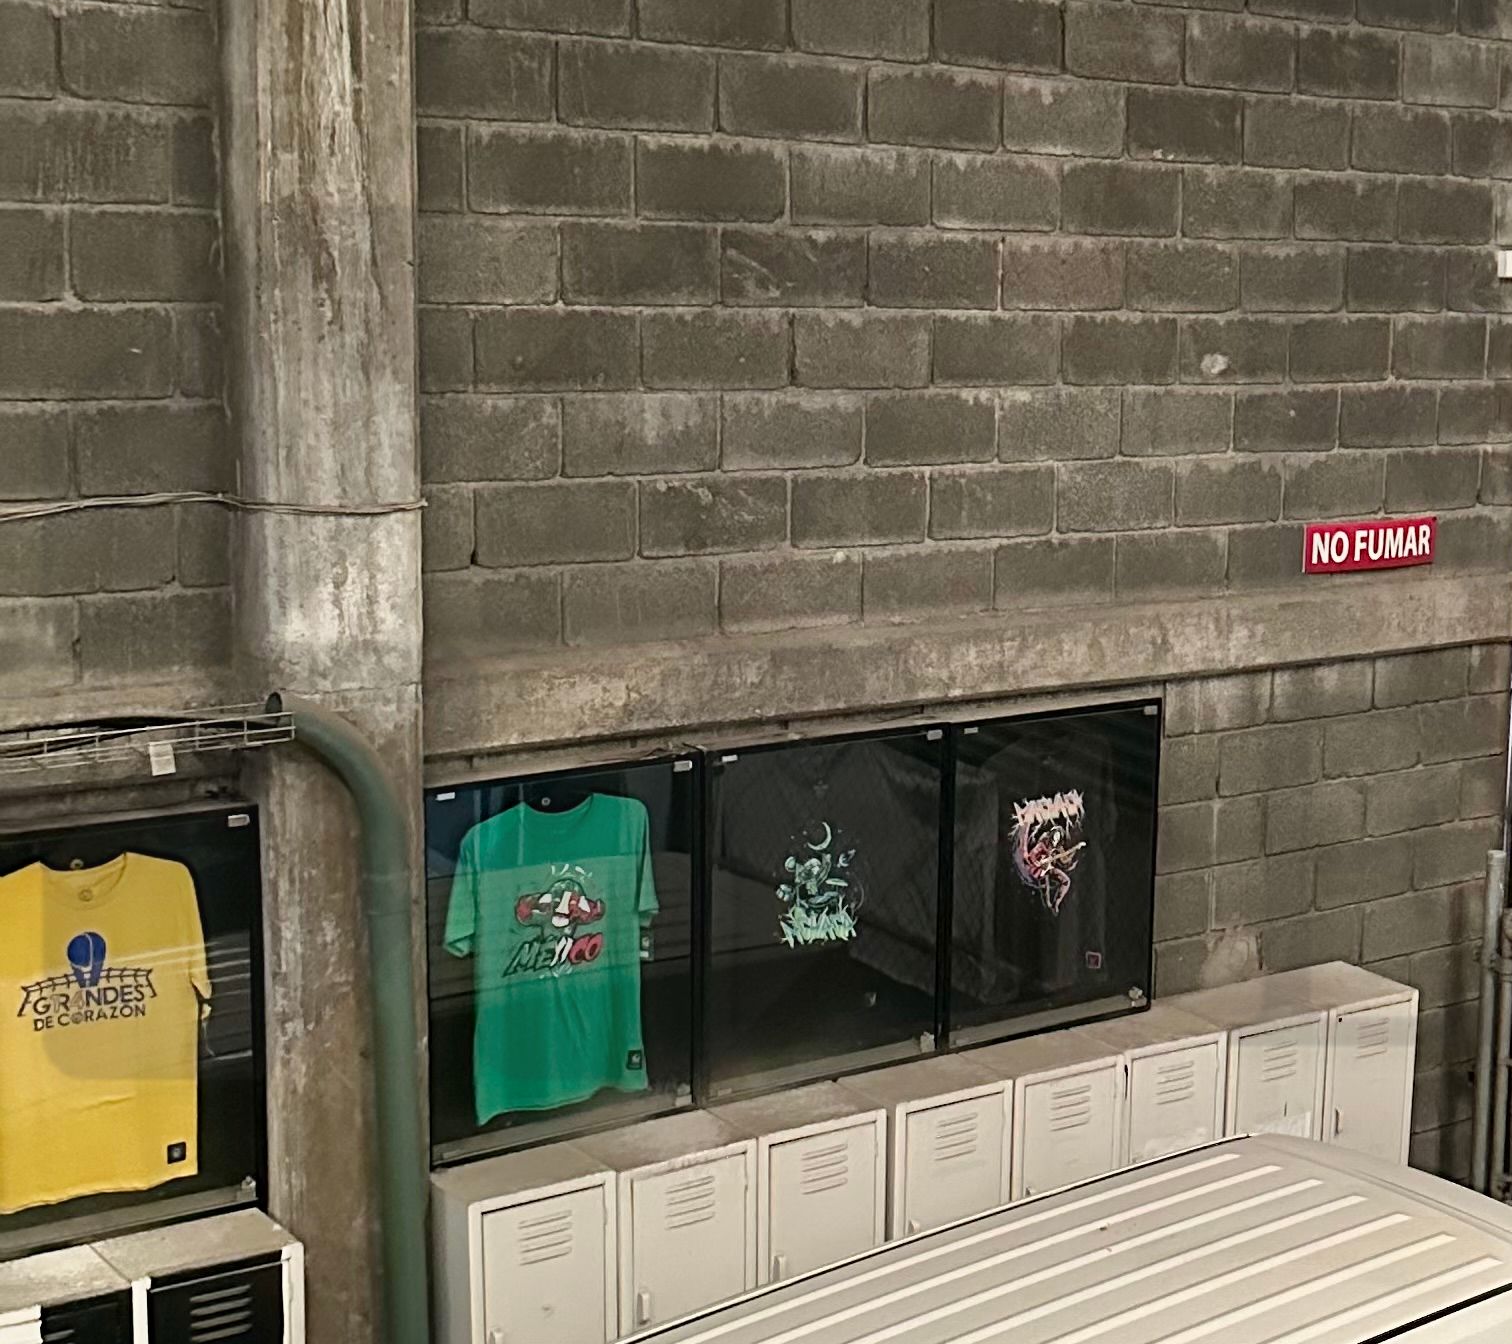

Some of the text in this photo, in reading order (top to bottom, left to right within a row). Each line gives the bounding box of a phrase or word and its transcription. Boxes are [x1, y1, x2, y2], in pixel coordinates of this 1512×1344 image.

[1311, 524, 1431, 565] NO FUMAR
[33, 1015, 55, 1032] DE
